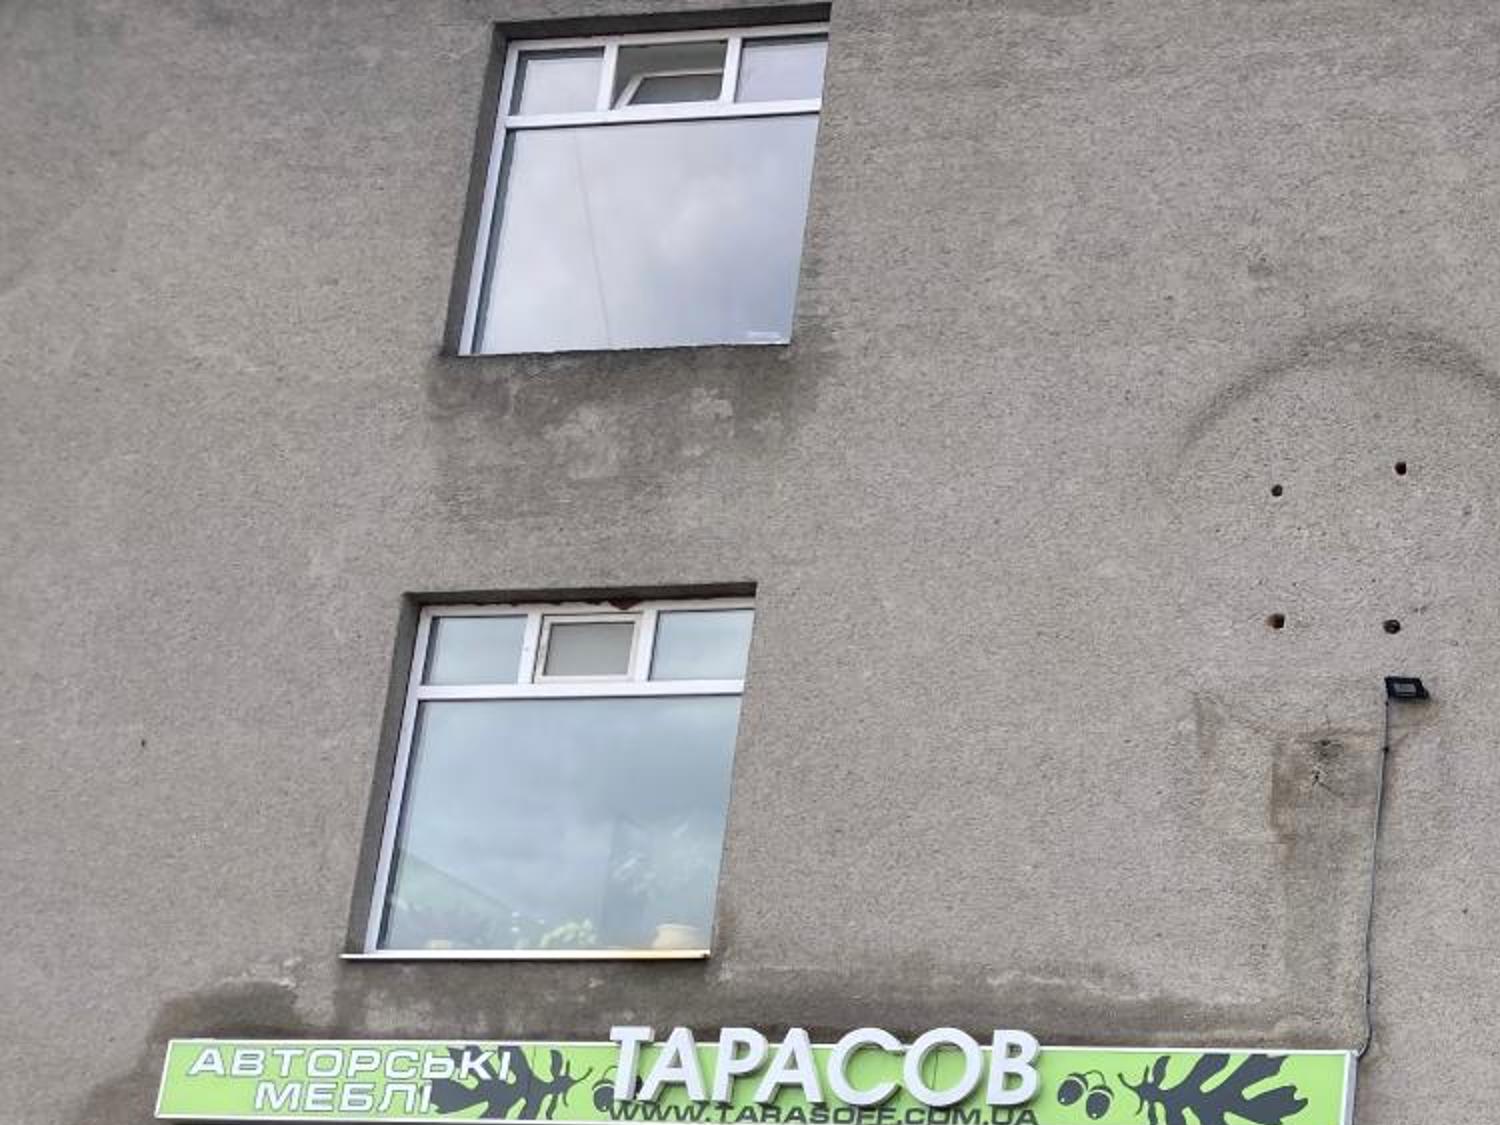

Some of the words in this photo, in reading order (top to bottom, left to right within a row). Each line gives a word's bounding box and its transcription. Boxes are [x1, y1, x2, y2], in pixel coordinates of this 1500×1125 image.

[185, 1049, 512, 1081] АВТОРСЬКІ
[608, 1026, 1042, 1107] ТАРАСОВ
[252, 1081, 434, 1113] МЕБЛІ
